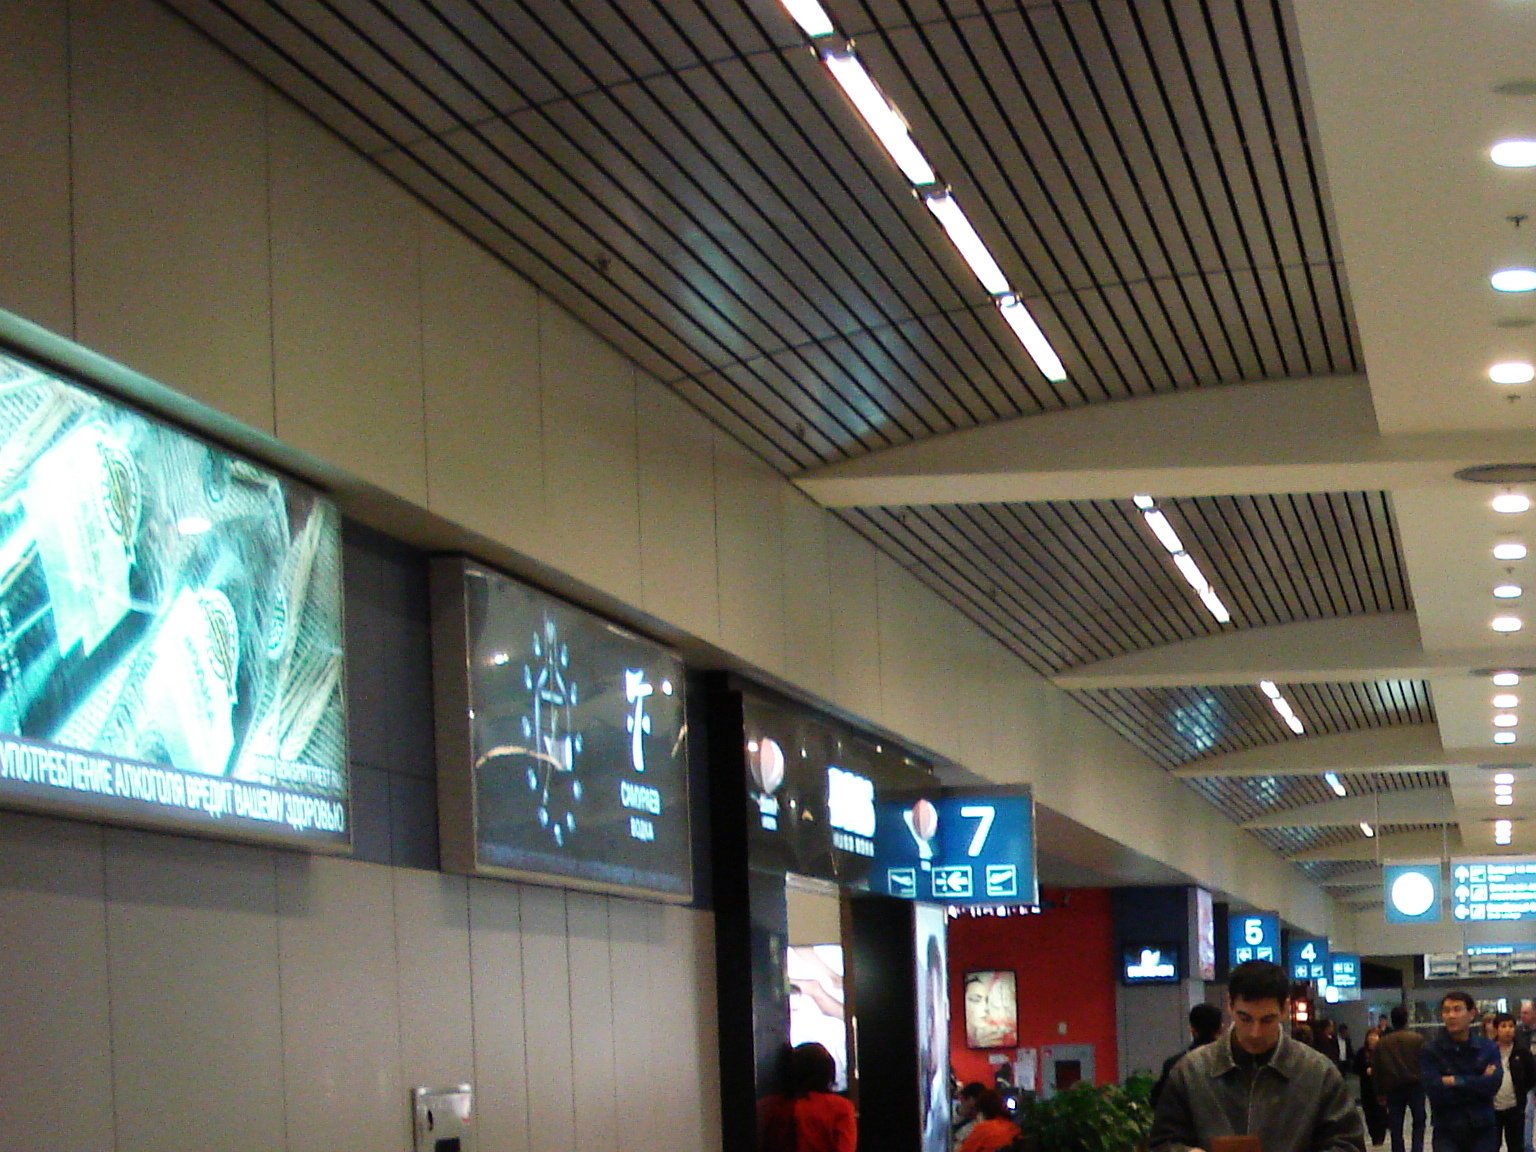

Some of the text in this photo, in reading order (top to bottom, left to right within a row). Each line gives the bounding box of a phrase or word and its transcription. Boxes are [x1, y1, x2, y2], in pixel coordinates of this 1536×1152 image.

[0, 741, 344, 832] УПОТРЕБЛЕНИЕ АЛКОГОЛЯ ВРЕДИТ ВАШЕМУ ЗДОРОВЬЮ
[960, 806, 996, 857] 7
[1245, 918, 1264, 946] 5
[1300, 943, 1316, 962] 4
